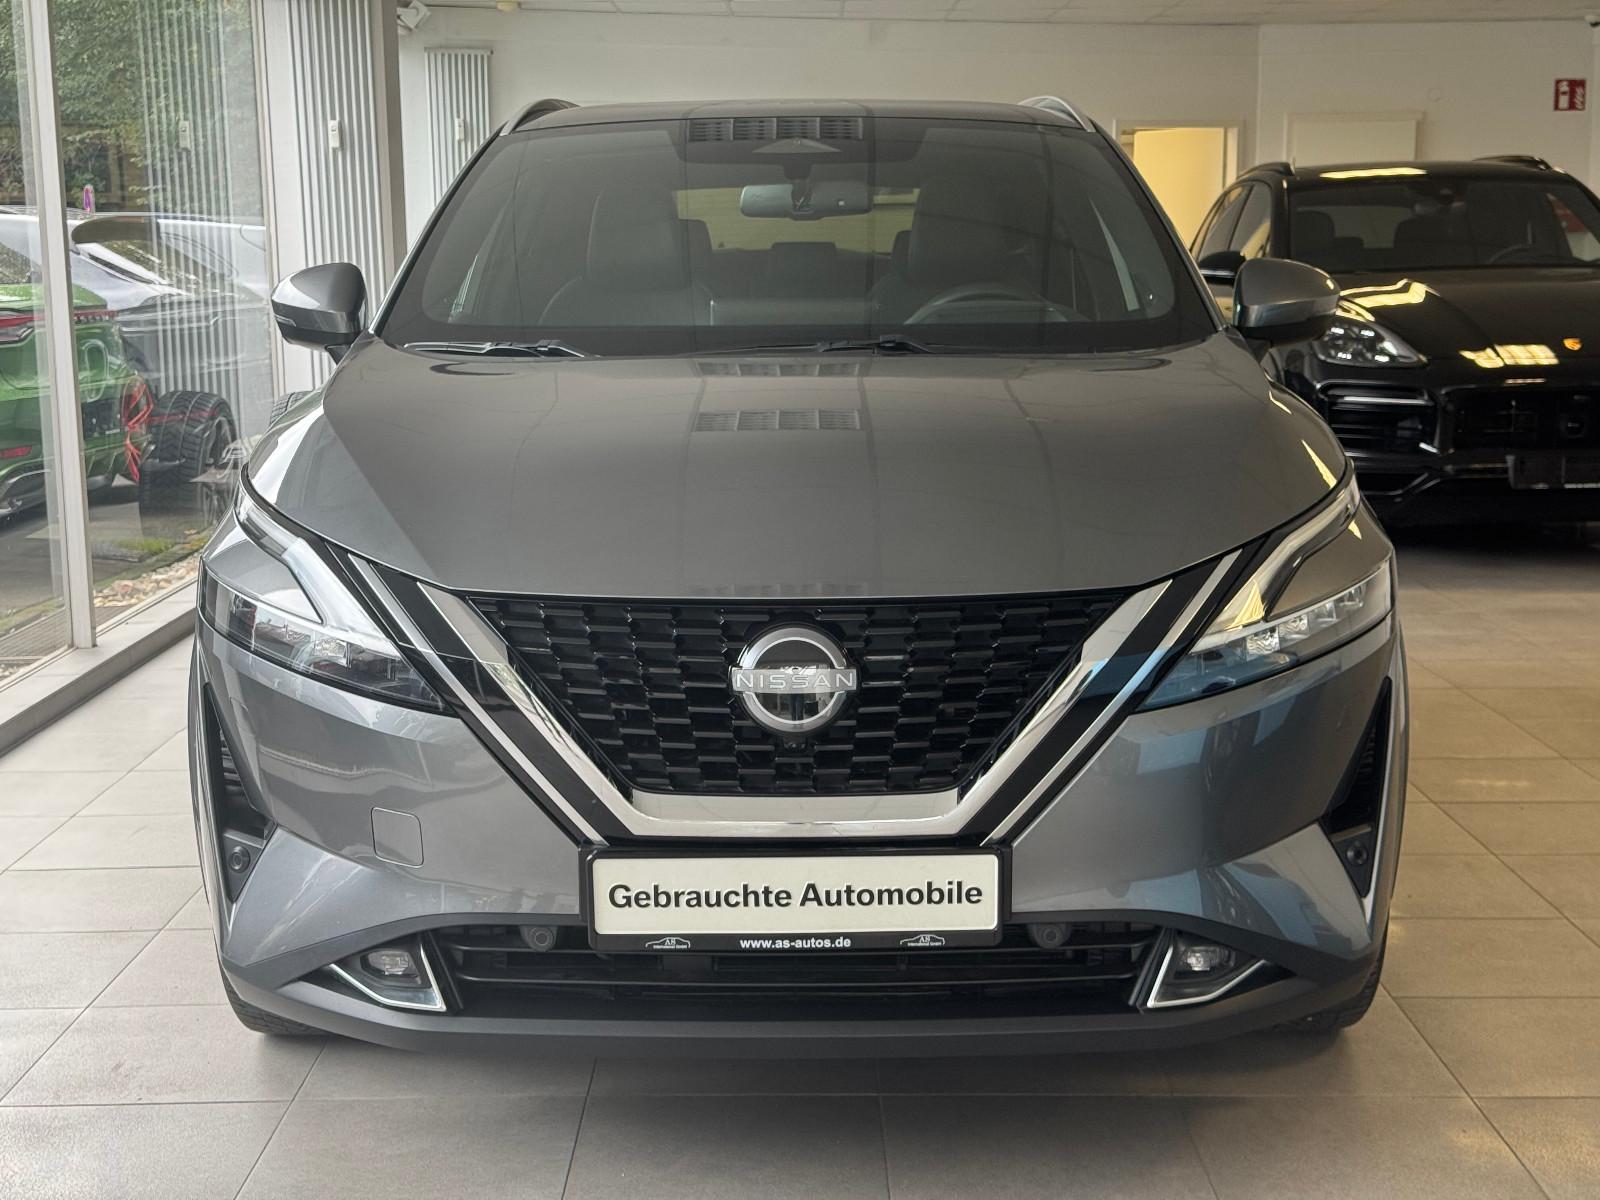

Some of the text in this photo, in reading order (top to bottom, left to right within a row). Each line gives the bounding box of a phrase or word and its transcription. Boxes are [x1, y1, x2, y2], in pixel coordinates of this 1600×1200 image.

[736, 673, 853, 689] NISSAN
[608, 881, 983, 908] Gebrauchte Automobile
[740, 936, 852, 949] www.as-autos.de
